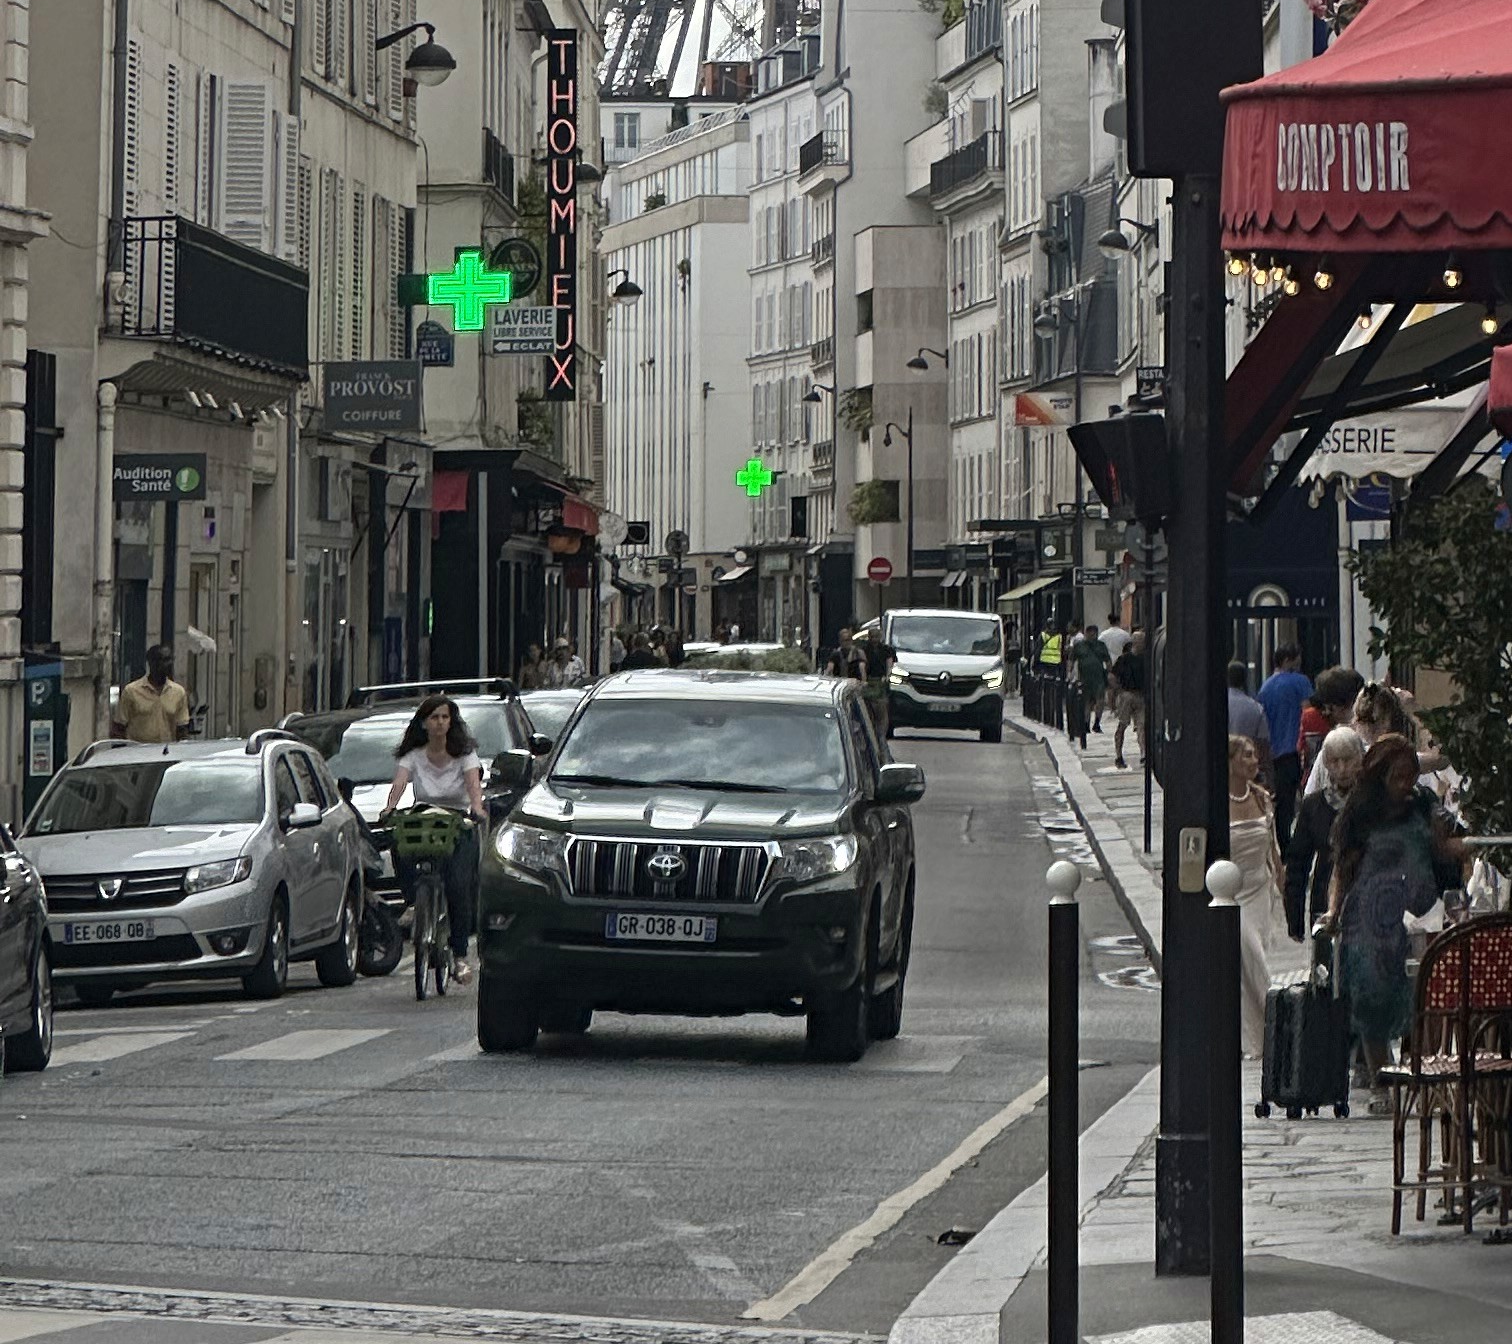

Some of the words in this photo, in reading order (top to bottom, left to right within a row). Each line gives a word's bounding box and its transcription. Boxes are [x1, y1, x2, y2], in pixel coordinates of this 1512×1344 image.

[1276, 121, 1411, 194] COMPTOIR
[548, 39, 575, 391] THOUMIEUX
[494, 308, 553, 325] LAVERIE
[494, 327, 517, 338] LIBRE
[518, 326, 553, 337] SERVICE
[512, 342, 553, 351] ECLAT
[1137, 368, 1165, 380] RESTA
[329, 379, 416, 397] PROVOST
[342, 409, 402, 422] COIFFURE
[1317, 427, 1397, 454] SSERIE
[113, 466, 172, 480] Audition
[131, 479, 172, 492] Santé
